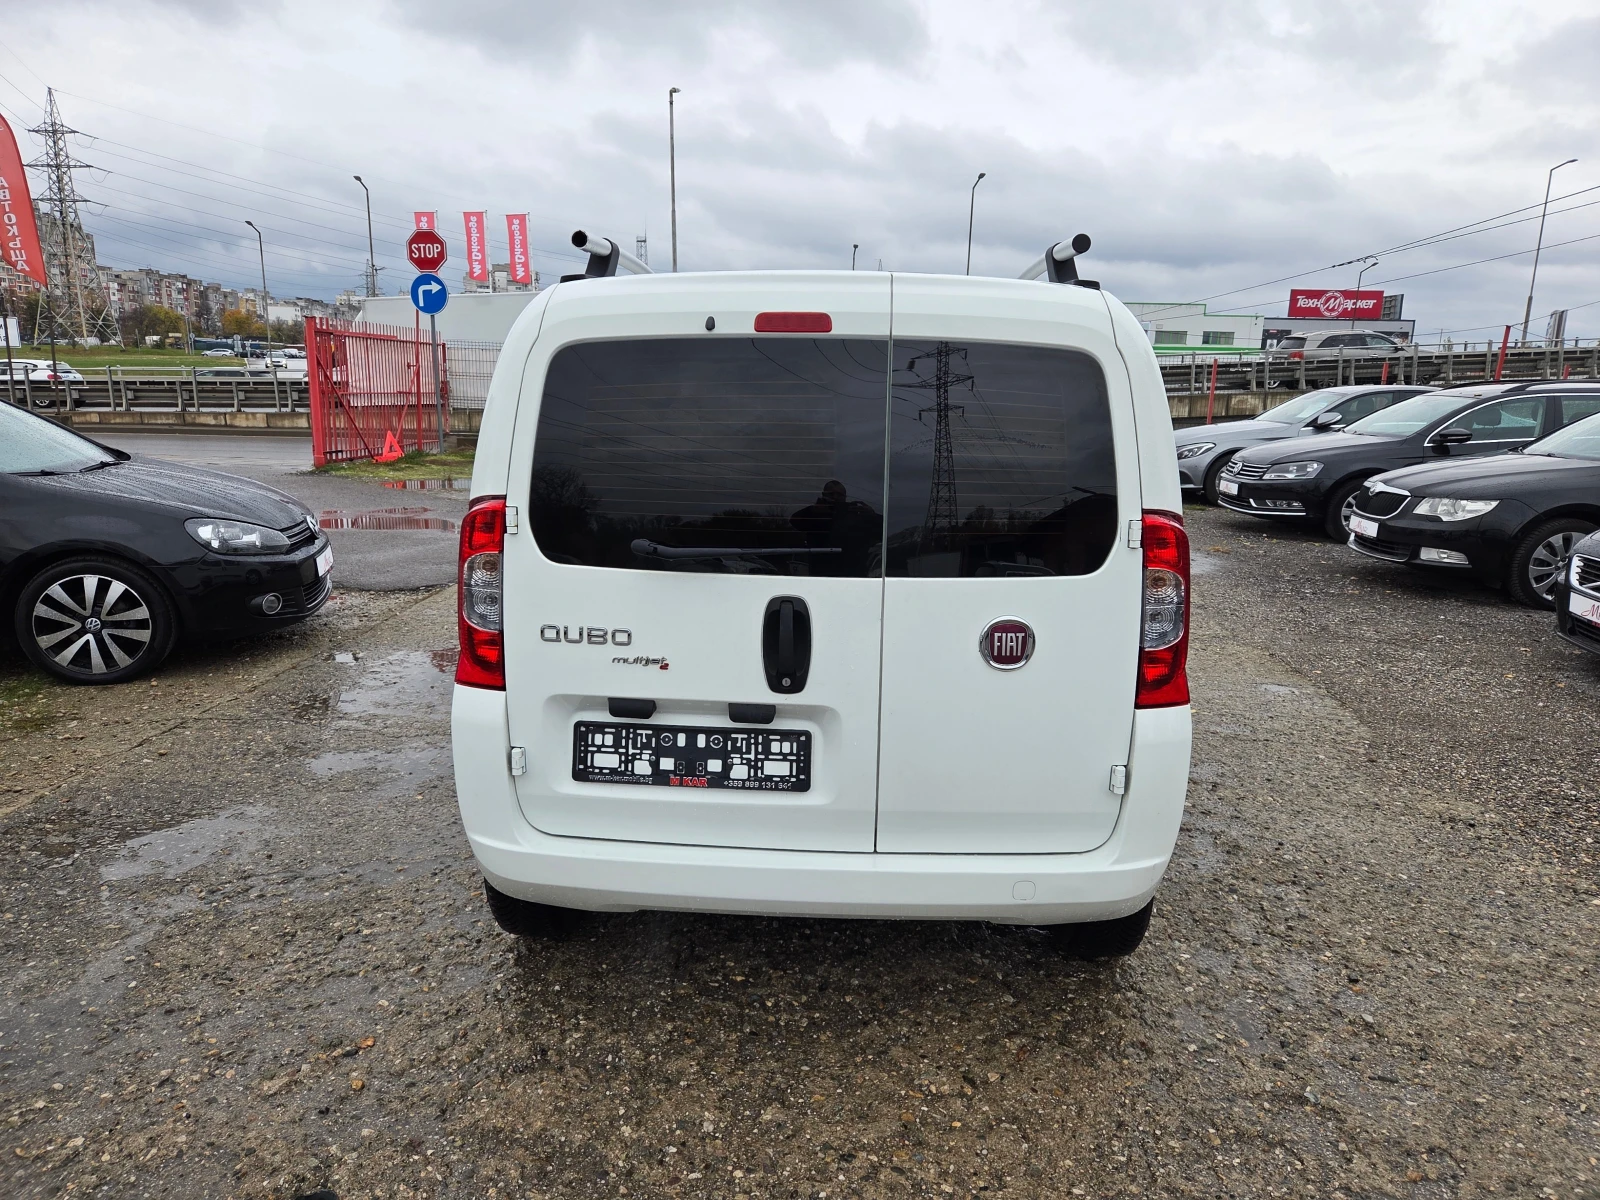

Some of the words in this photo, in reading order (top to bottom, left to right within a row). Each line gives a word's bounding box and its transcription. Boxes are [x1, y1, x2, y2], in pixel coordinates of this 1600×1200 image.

[411, 243, 441, 258] STOP
[540, 624, 632, 646] QUBO
[993, 632, 1025, 656] FIAT
[611, 655, 667, 666] multijet
[670, 776, 680, 786] M
[683, 777, 708, 787] KAR
